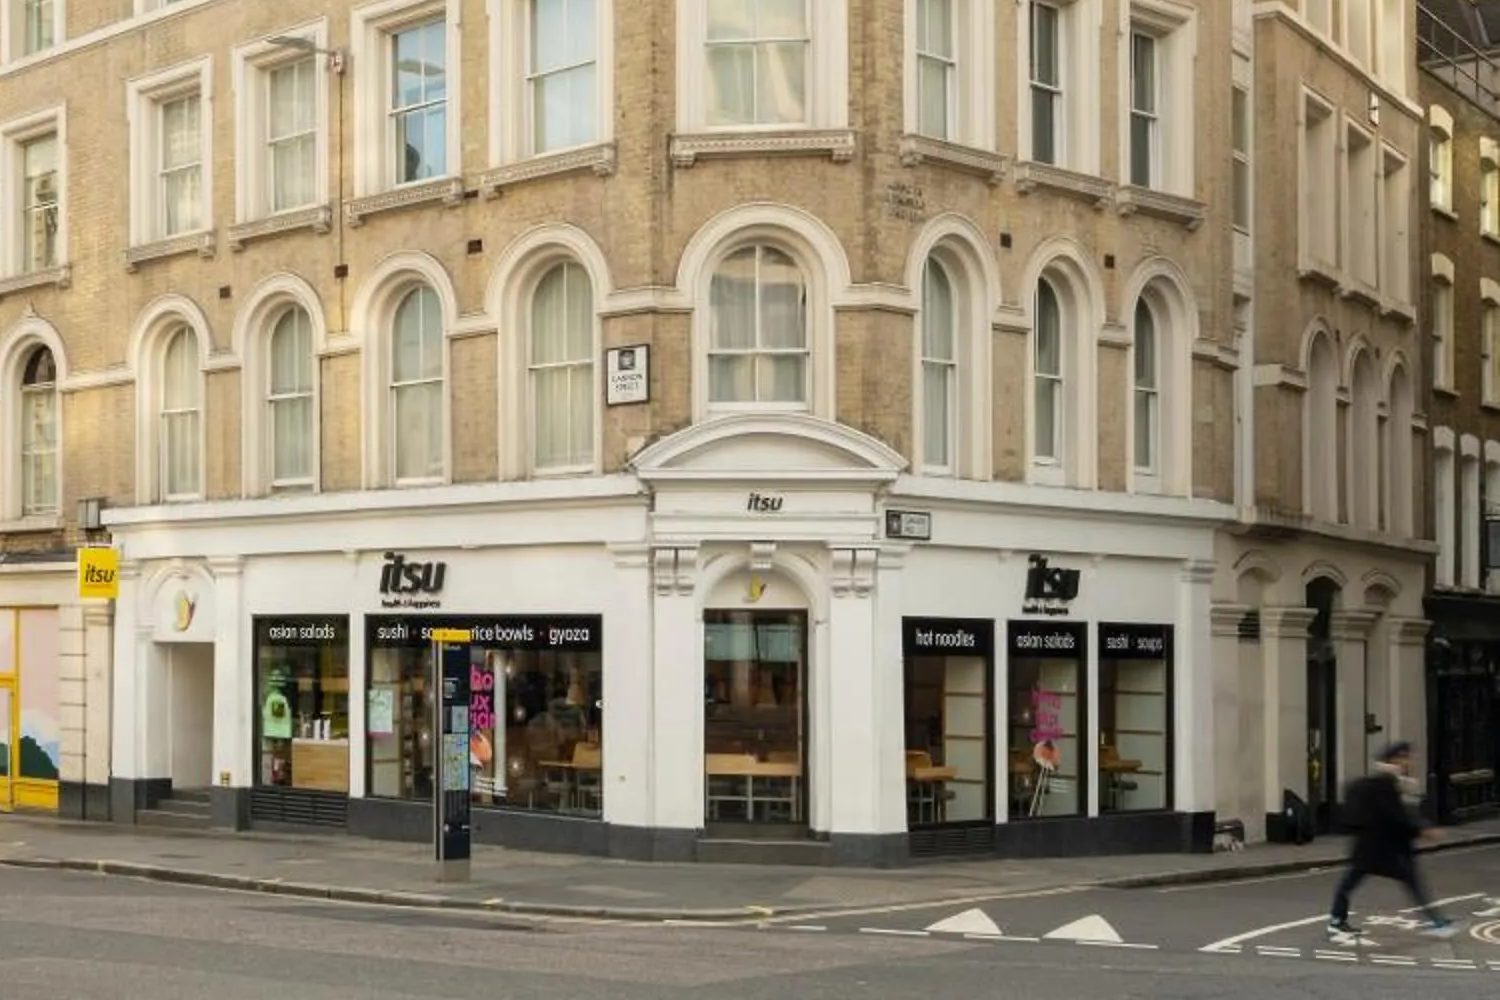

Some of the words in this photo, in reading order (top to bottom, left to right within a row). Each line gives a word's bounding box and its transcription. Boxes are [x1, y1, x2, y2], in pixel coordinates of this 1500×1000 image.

[747, 493, 783, 511] itsu
[85, 562, 115, 583] itsu
[380, 551, 446, 594] itsu
[1024, 554, 1081, 603] itsu
[269, 625, 297, 639] asian
[300, 624, 335, 639] salads
[377, 624, 408, 639] sushi
[471, 625, 493, 641] rice
[495, 624, 534, 641] bowls
[549, 627, 589, 645] gyoza
[916, 628, 933, 646] hot
[935, 628, 975, 647] noodles
[1016, 632, 1043, 648] asian
